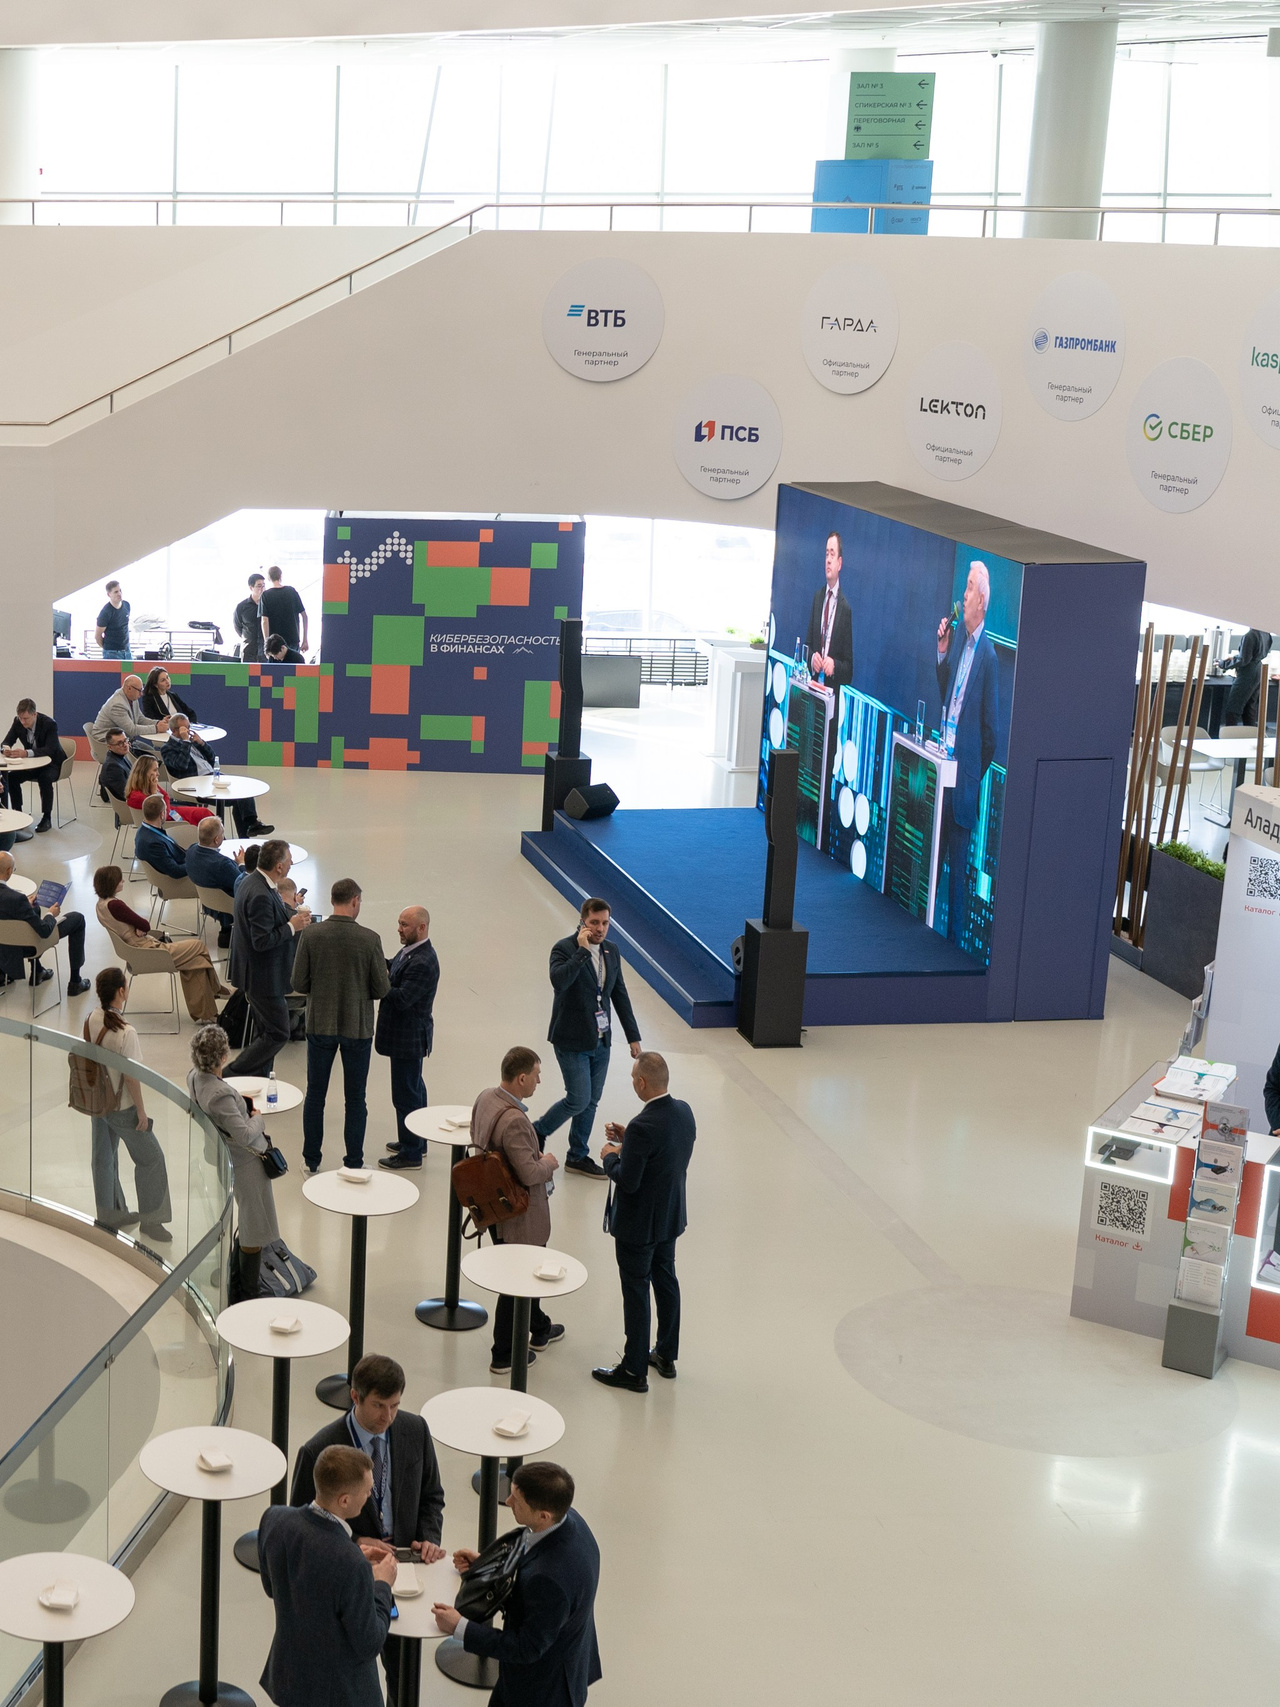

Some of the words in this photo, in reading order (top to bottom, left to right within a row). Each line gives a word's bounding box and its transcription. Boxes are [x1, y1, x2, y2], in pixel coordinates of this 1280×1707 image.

[586, 308, 626, 328] ВТБ
[820, 316, 878, 333] ГАРДА
[1053, 335, 1117, 353] ГАЗПРОМБАНК
[573, 349, 629, 358] Генеральный
[584, 358, 619, 367] партнер
[822, 358, 870, 370] Официальный
[1251, 346, 1280, 374] kas
[831, 368, 860, 379] партнер
[1047, 381, 1092, 394] Генеральный
[1055, 393, 1084, 405] партнер
[1271, 419, 1280, 429] па
[720, 425, 760, 443] ПСБ
[1167, 420, 1214, 443] СБЕР
[925, 442, 973, 456] Официальный
[935, 455, 962, 465] партнер
[700, 465, 750, 477] Генеральный
[709, 476, 741, 485] партнер
[1150, 470, 1198, 486] Генеральный
[1159, 482, 1190, 496] партнер
[430, 634, 561, 646] КИБЕРБЕЗОПАСНОСТЬ
[430, 644, 438, 652] В
[440, 644, 505, 654] ФИНАНСАХ
[1244, 808, 1280, 844] Алад
[1244, 905, 1276, 916] Каталог
[1095, 1234, 1129, 1248] Каталог
